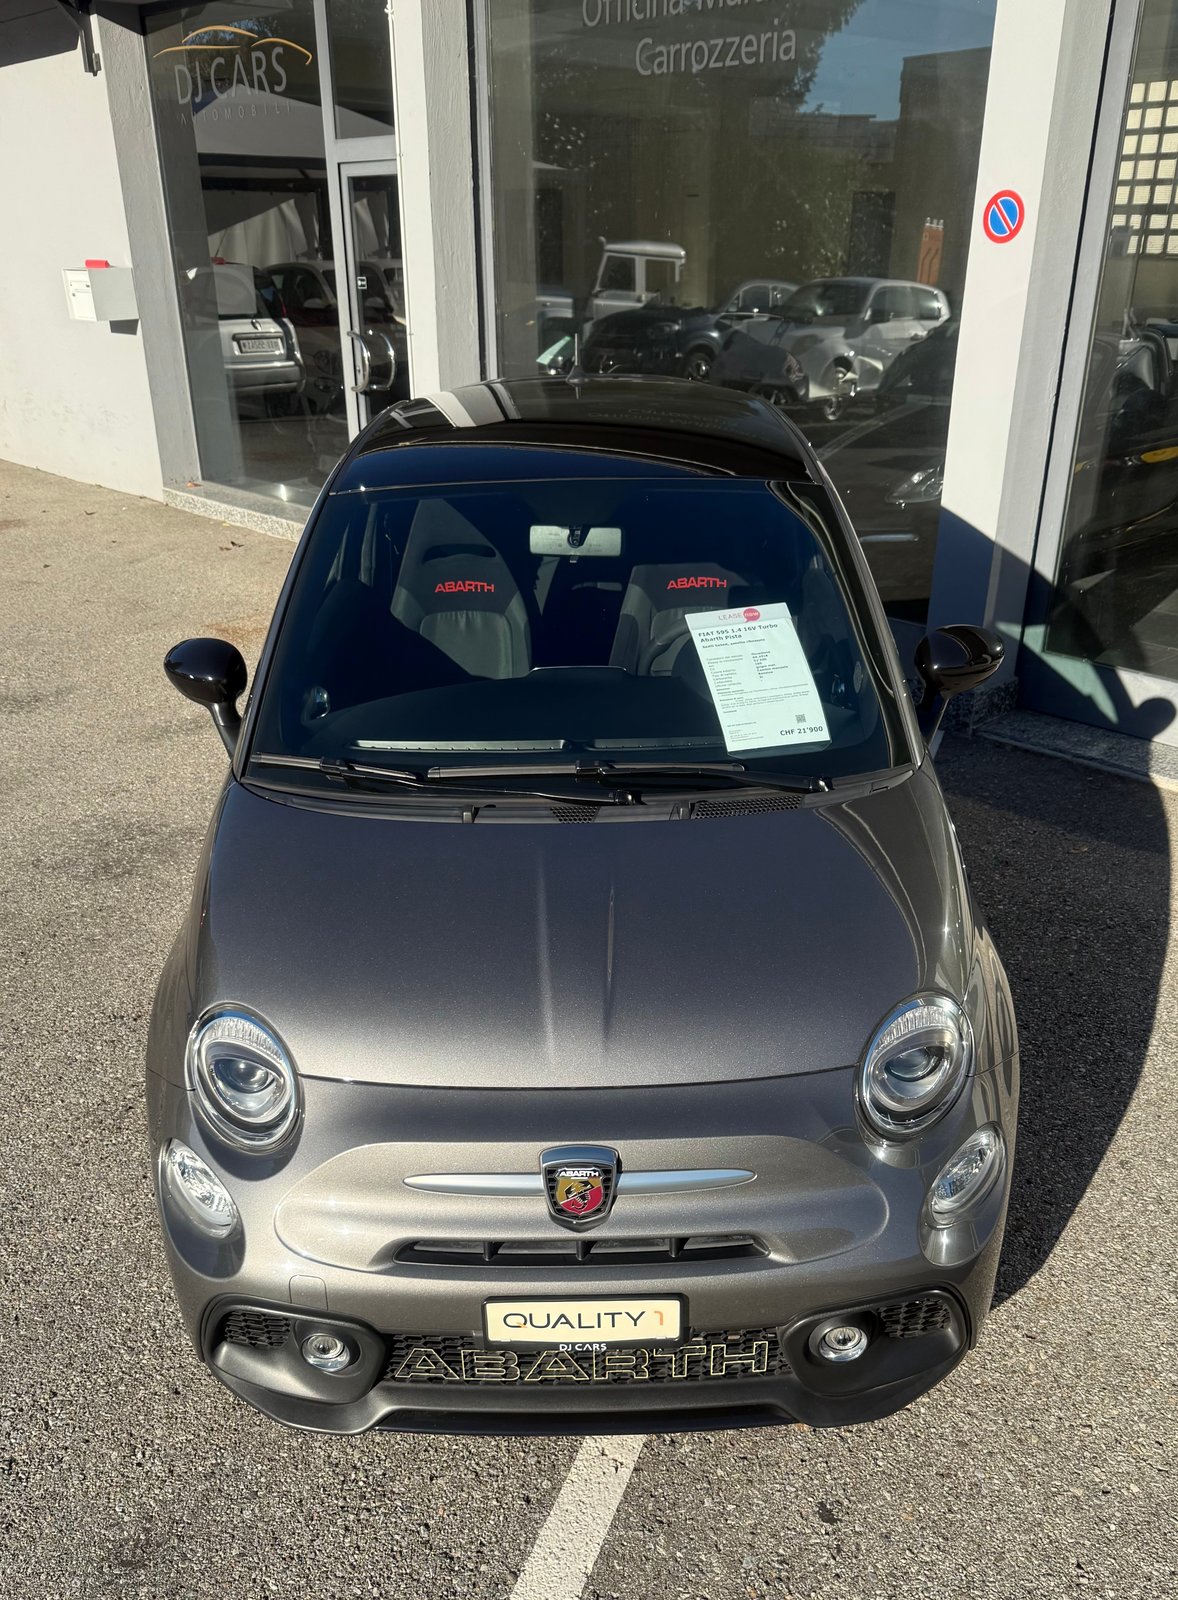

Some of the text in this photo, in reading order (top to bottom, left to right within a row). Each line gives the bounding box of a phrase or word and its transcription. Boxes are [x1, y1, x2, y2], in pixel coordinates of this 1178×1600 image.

[635, 17, 797, 76] Carrozzeria
[174, 46, 288, 105] DJ CARS
[178, 101, 291, 126] AUTOMOBILI
[434, 580, 495, 593] ABARTH
[666, 576, 727, 590] ABARTH
[718, 612, 743, 621] LEASE
[758, 623, 778, 631] Turbo
[700, 635, 724, 643] Abarth
[797, 725, 824, 735] 21'900
[502, 1310, 646, 1330] QUALITY
[559, 1342, 607, 1352] DJ CARS
[394, 1340, 769, 1382] ABARTH
